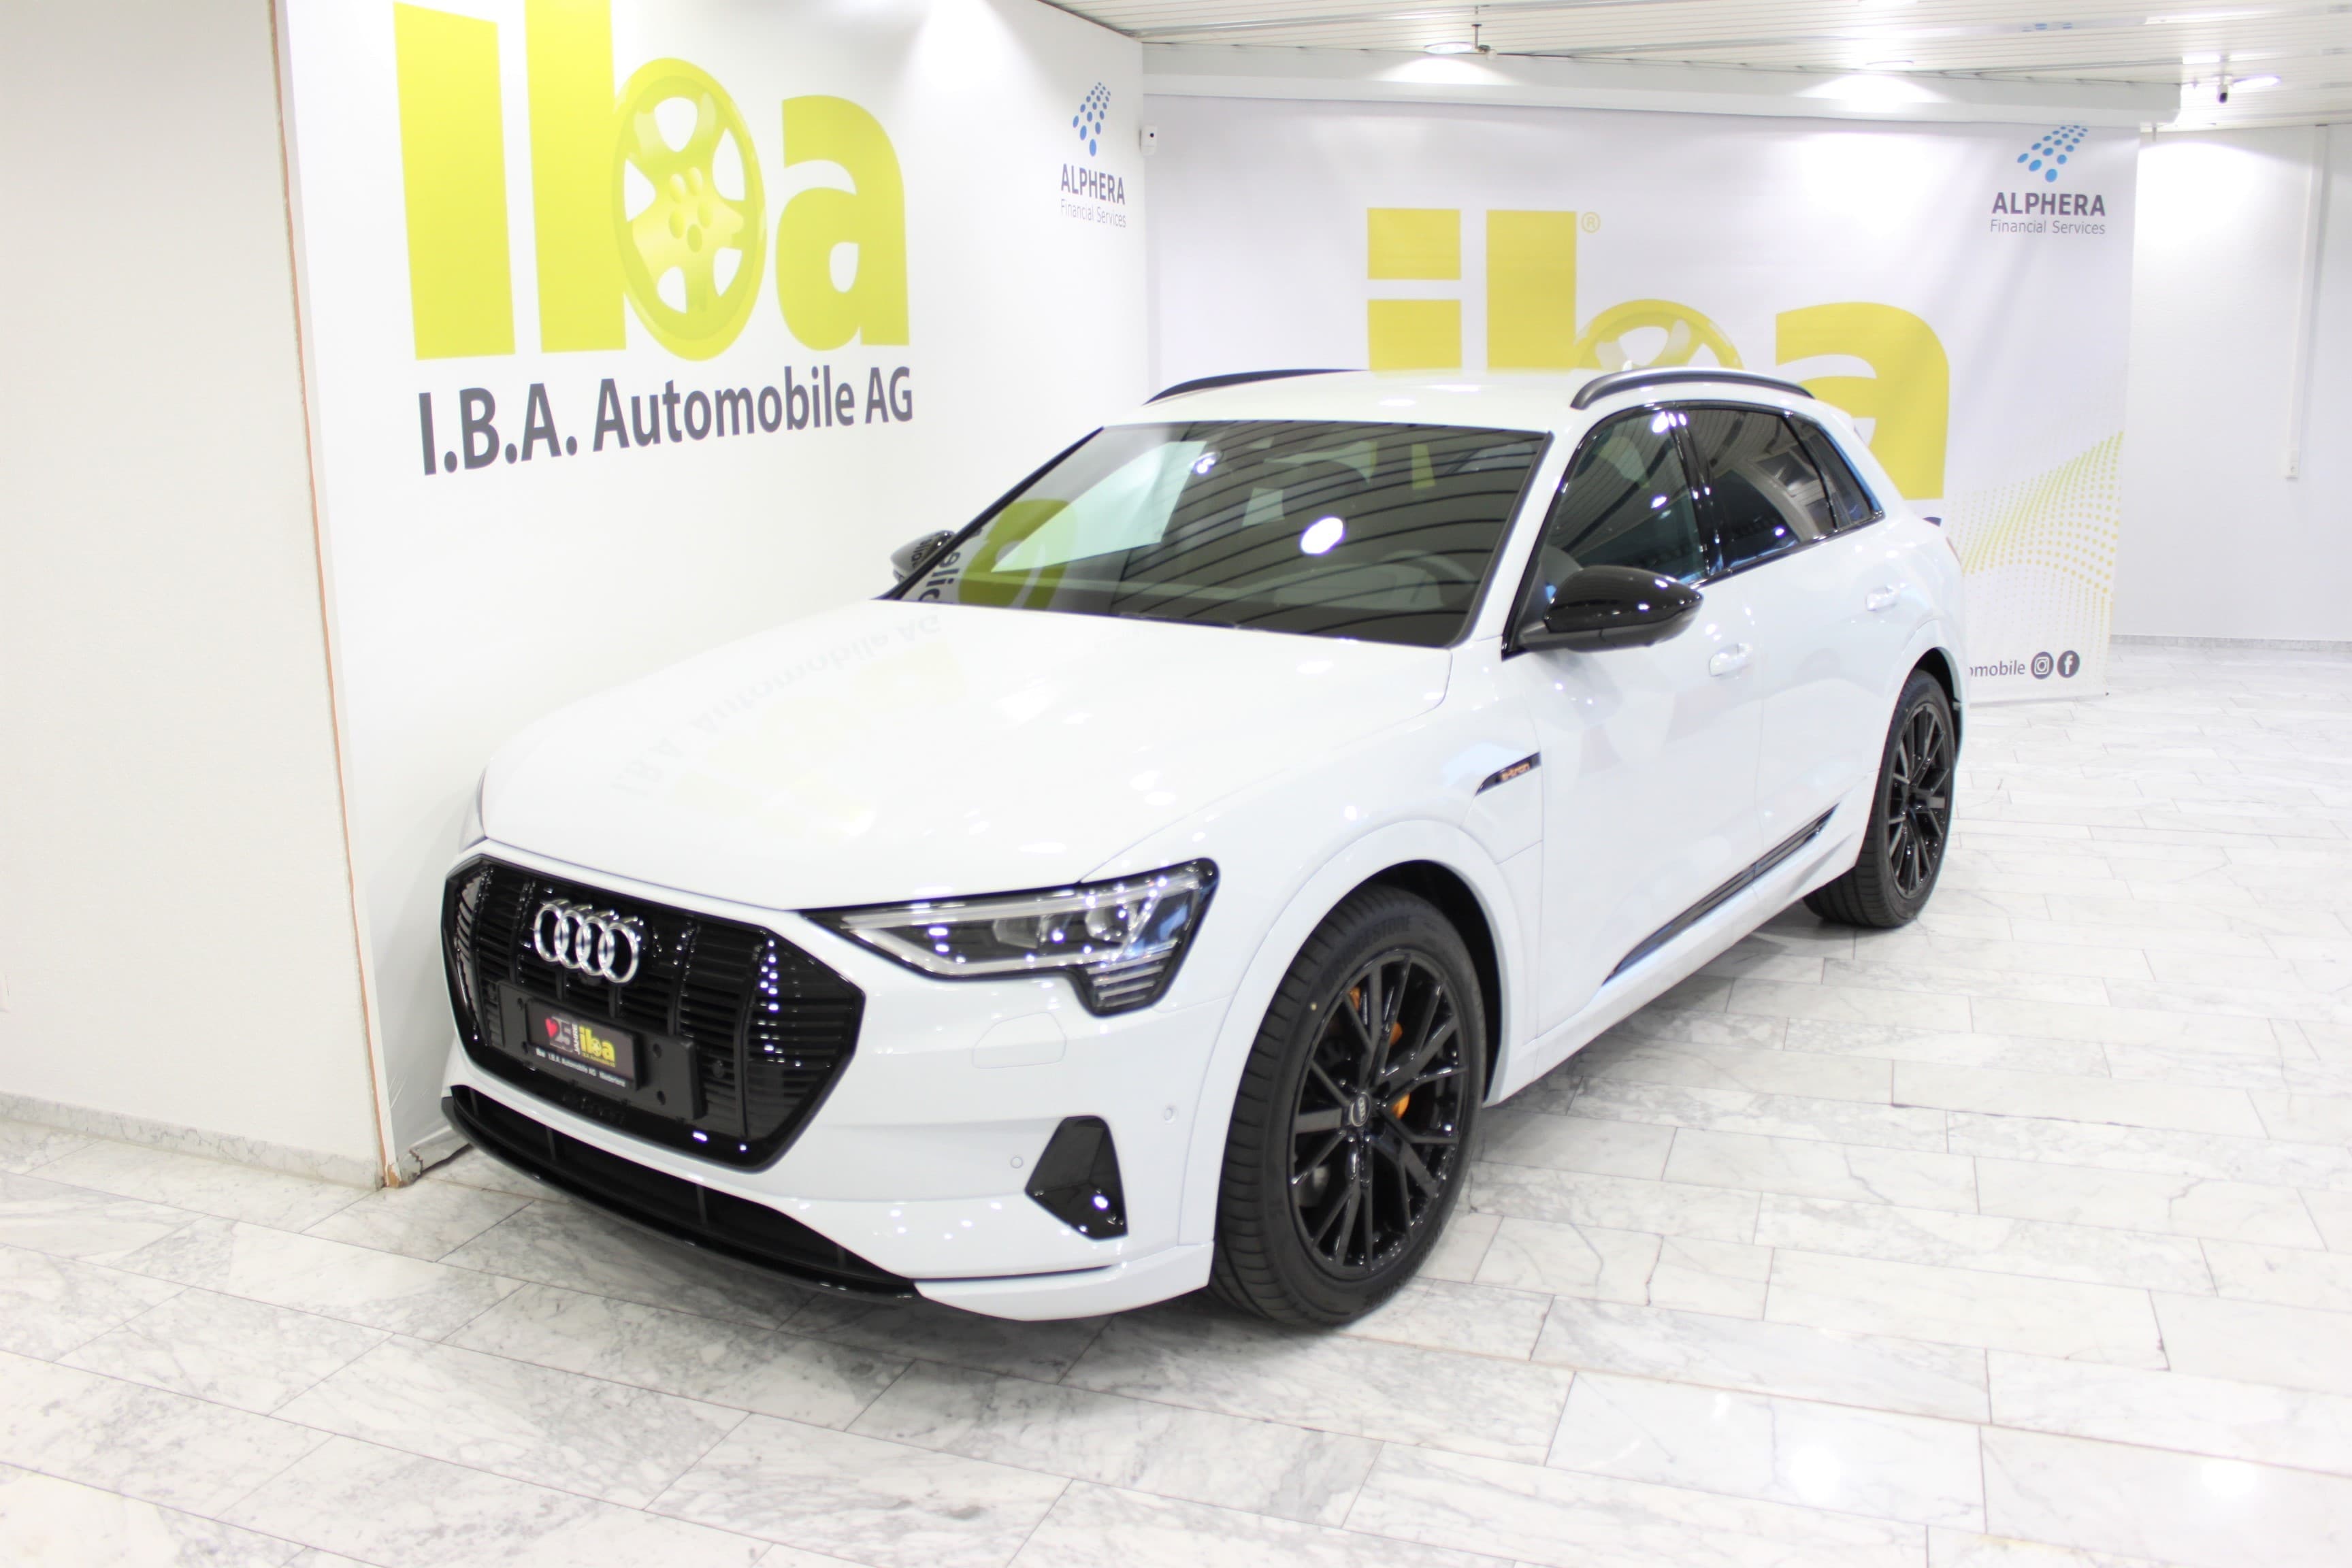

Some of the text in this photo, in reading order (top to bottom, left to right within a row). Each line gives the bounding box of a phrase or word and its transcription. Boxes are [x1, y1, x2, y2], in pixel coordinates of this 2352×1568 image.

[1061, 163, 1125, 205] ALPHERA
[1061, 199, 1126, 228] Financial Services
[1992, 192, 2106, 216] ALPHERA
[1990, 218, 2106, 235] Financial Services
[419, 365, 913, 476] I.B.A. Automobile AG
[578, 1026, 615, 1062] iba
